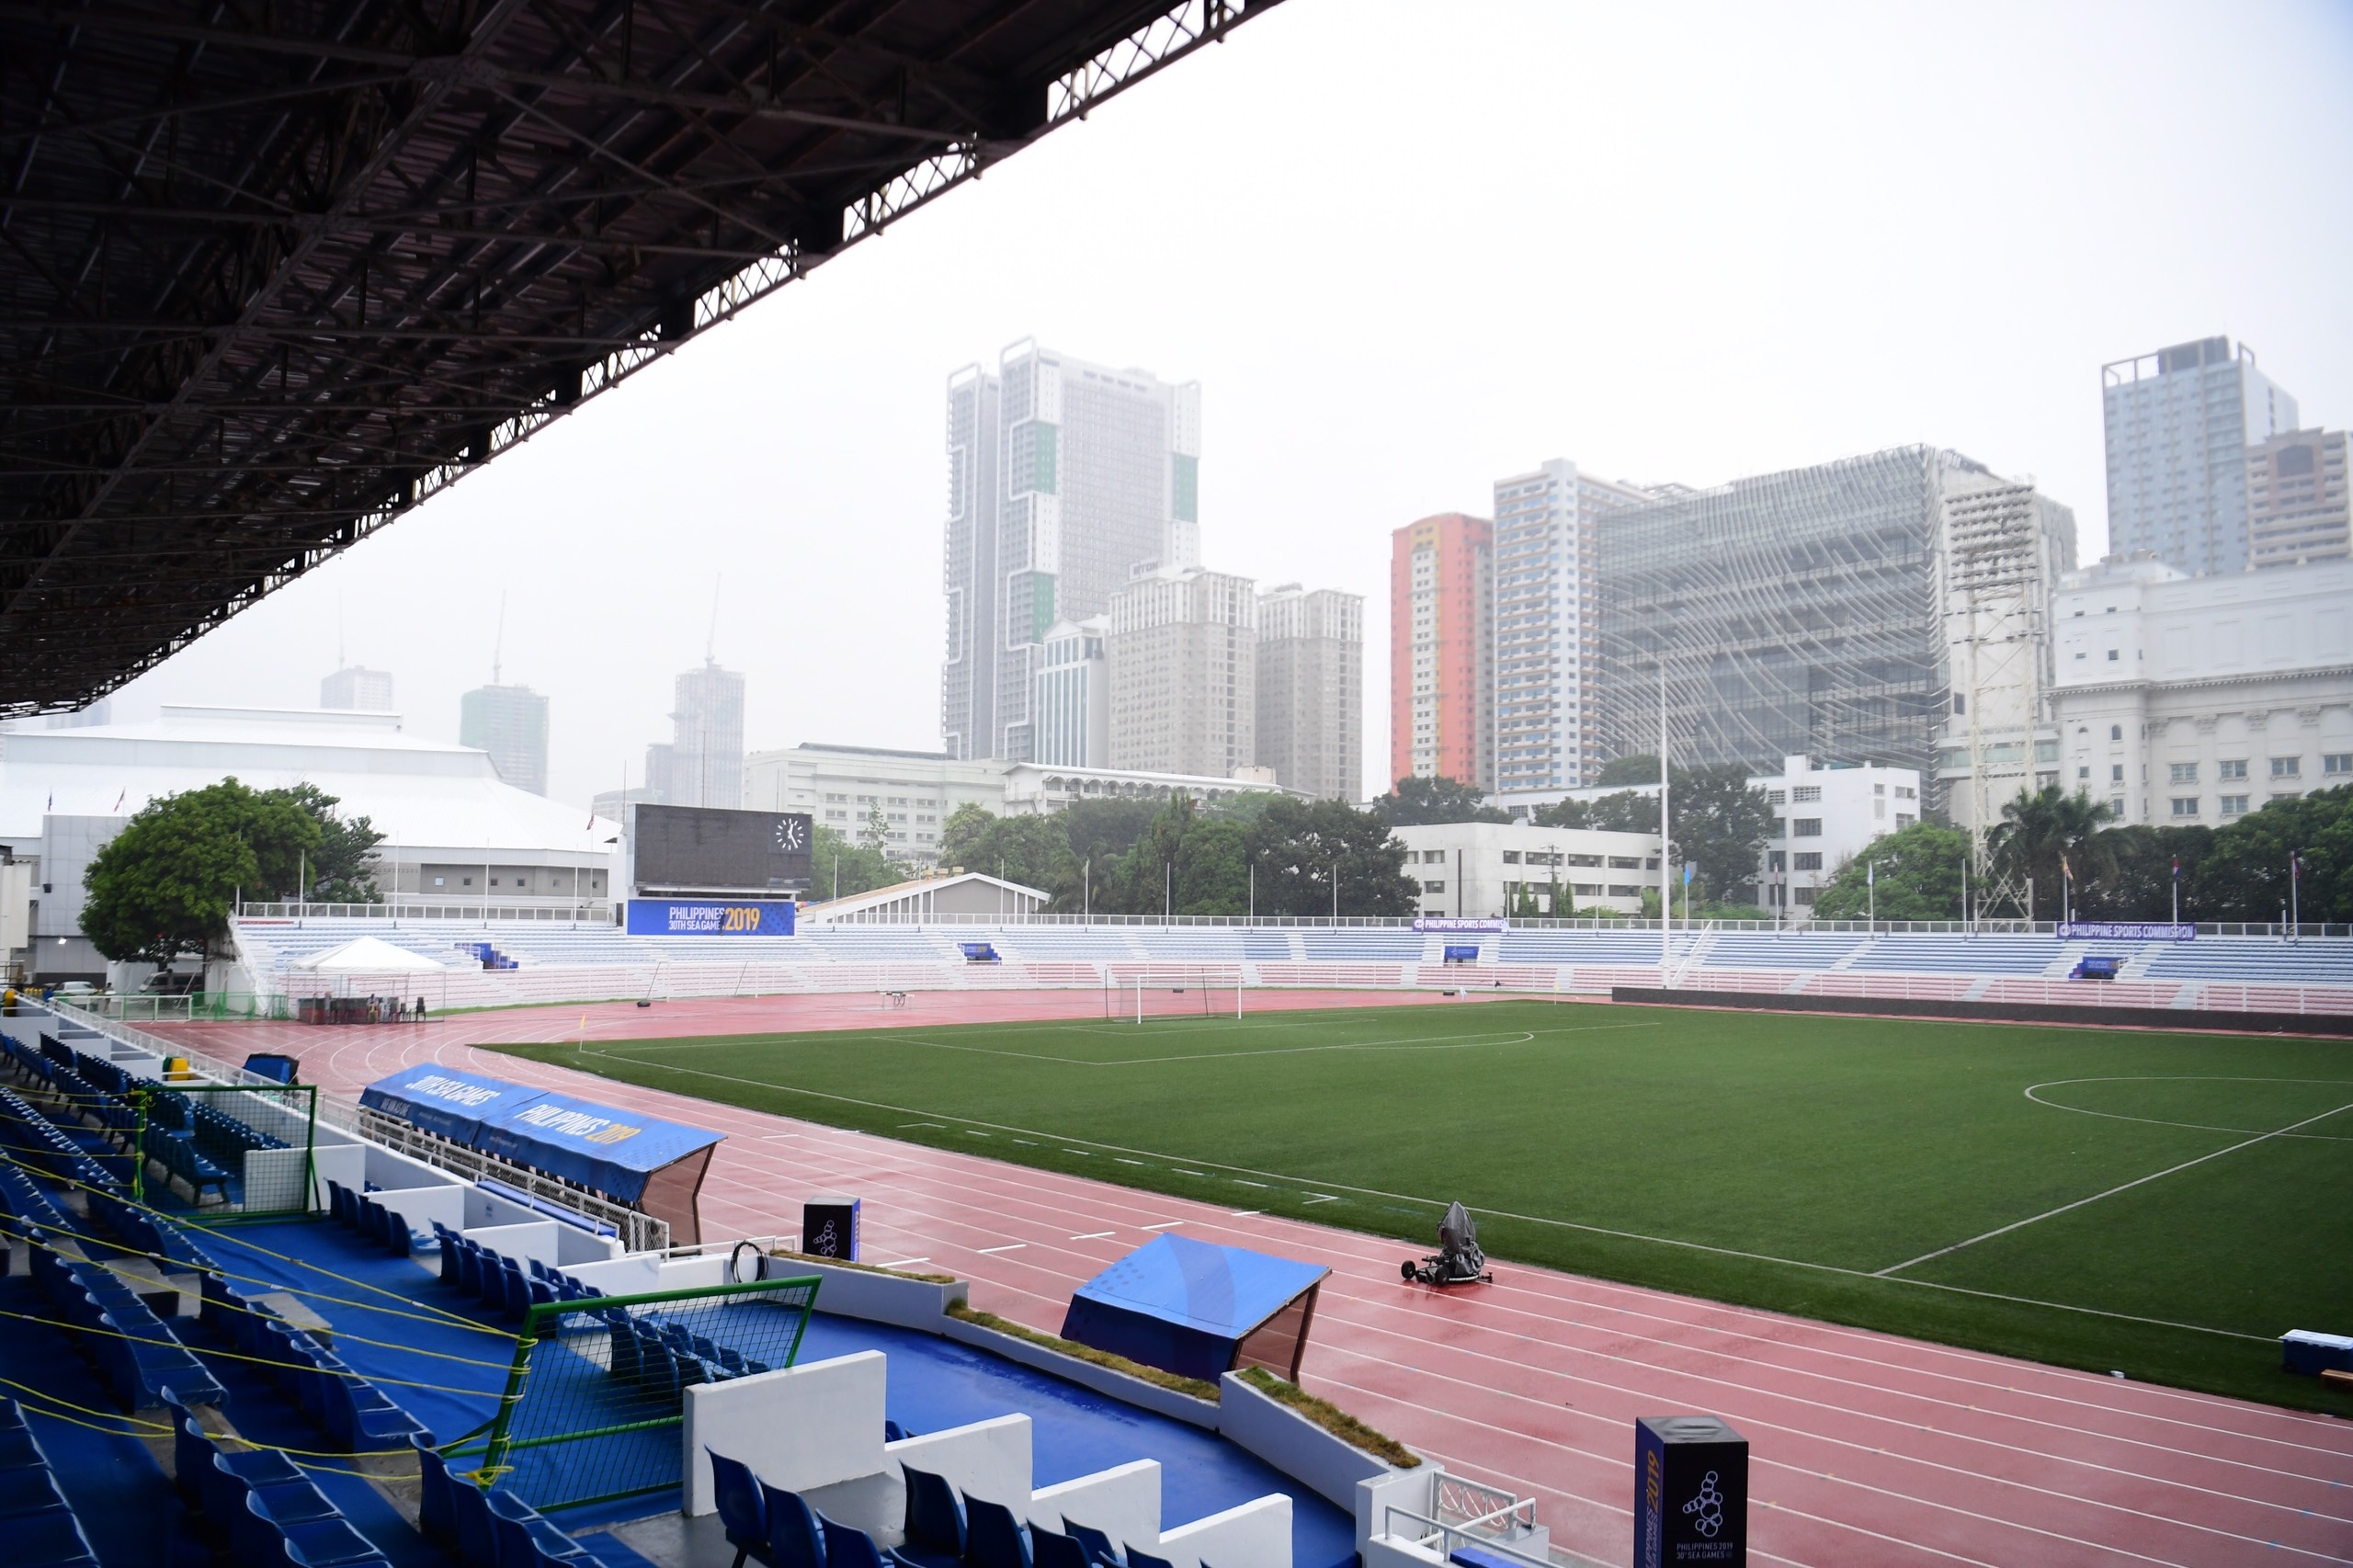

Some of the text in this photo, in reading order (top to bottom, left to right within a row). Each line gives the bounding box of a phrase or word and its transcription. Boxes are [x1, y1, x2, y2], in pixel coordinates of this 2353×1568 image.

[668, 920, 725, 931] 30TH SEA GAME
[669, 906, 761, 931] PHILIPPINES 2019
[1425, 919, 1457, 928] PHILIPPINE
[1457, 920, 1479, 928] SPORTS
[2072, 924, 2194, 938] PHILIPPINE SPORTS COMMISSION
[426, 1080, 467, 1098] SEA
[443, 1085, 502, 1107] GAMES
[513, 1103, 642, 1144] PHILIPPINES 2019
[1646, 1449, 1660, 1514] 2019
[1677, 1541, 1733, 1551] PHILIPPINES 2019
[1688, 1551, 1700, 1560] SEA
[1701, 1551, 1725, 1559] GAMES
